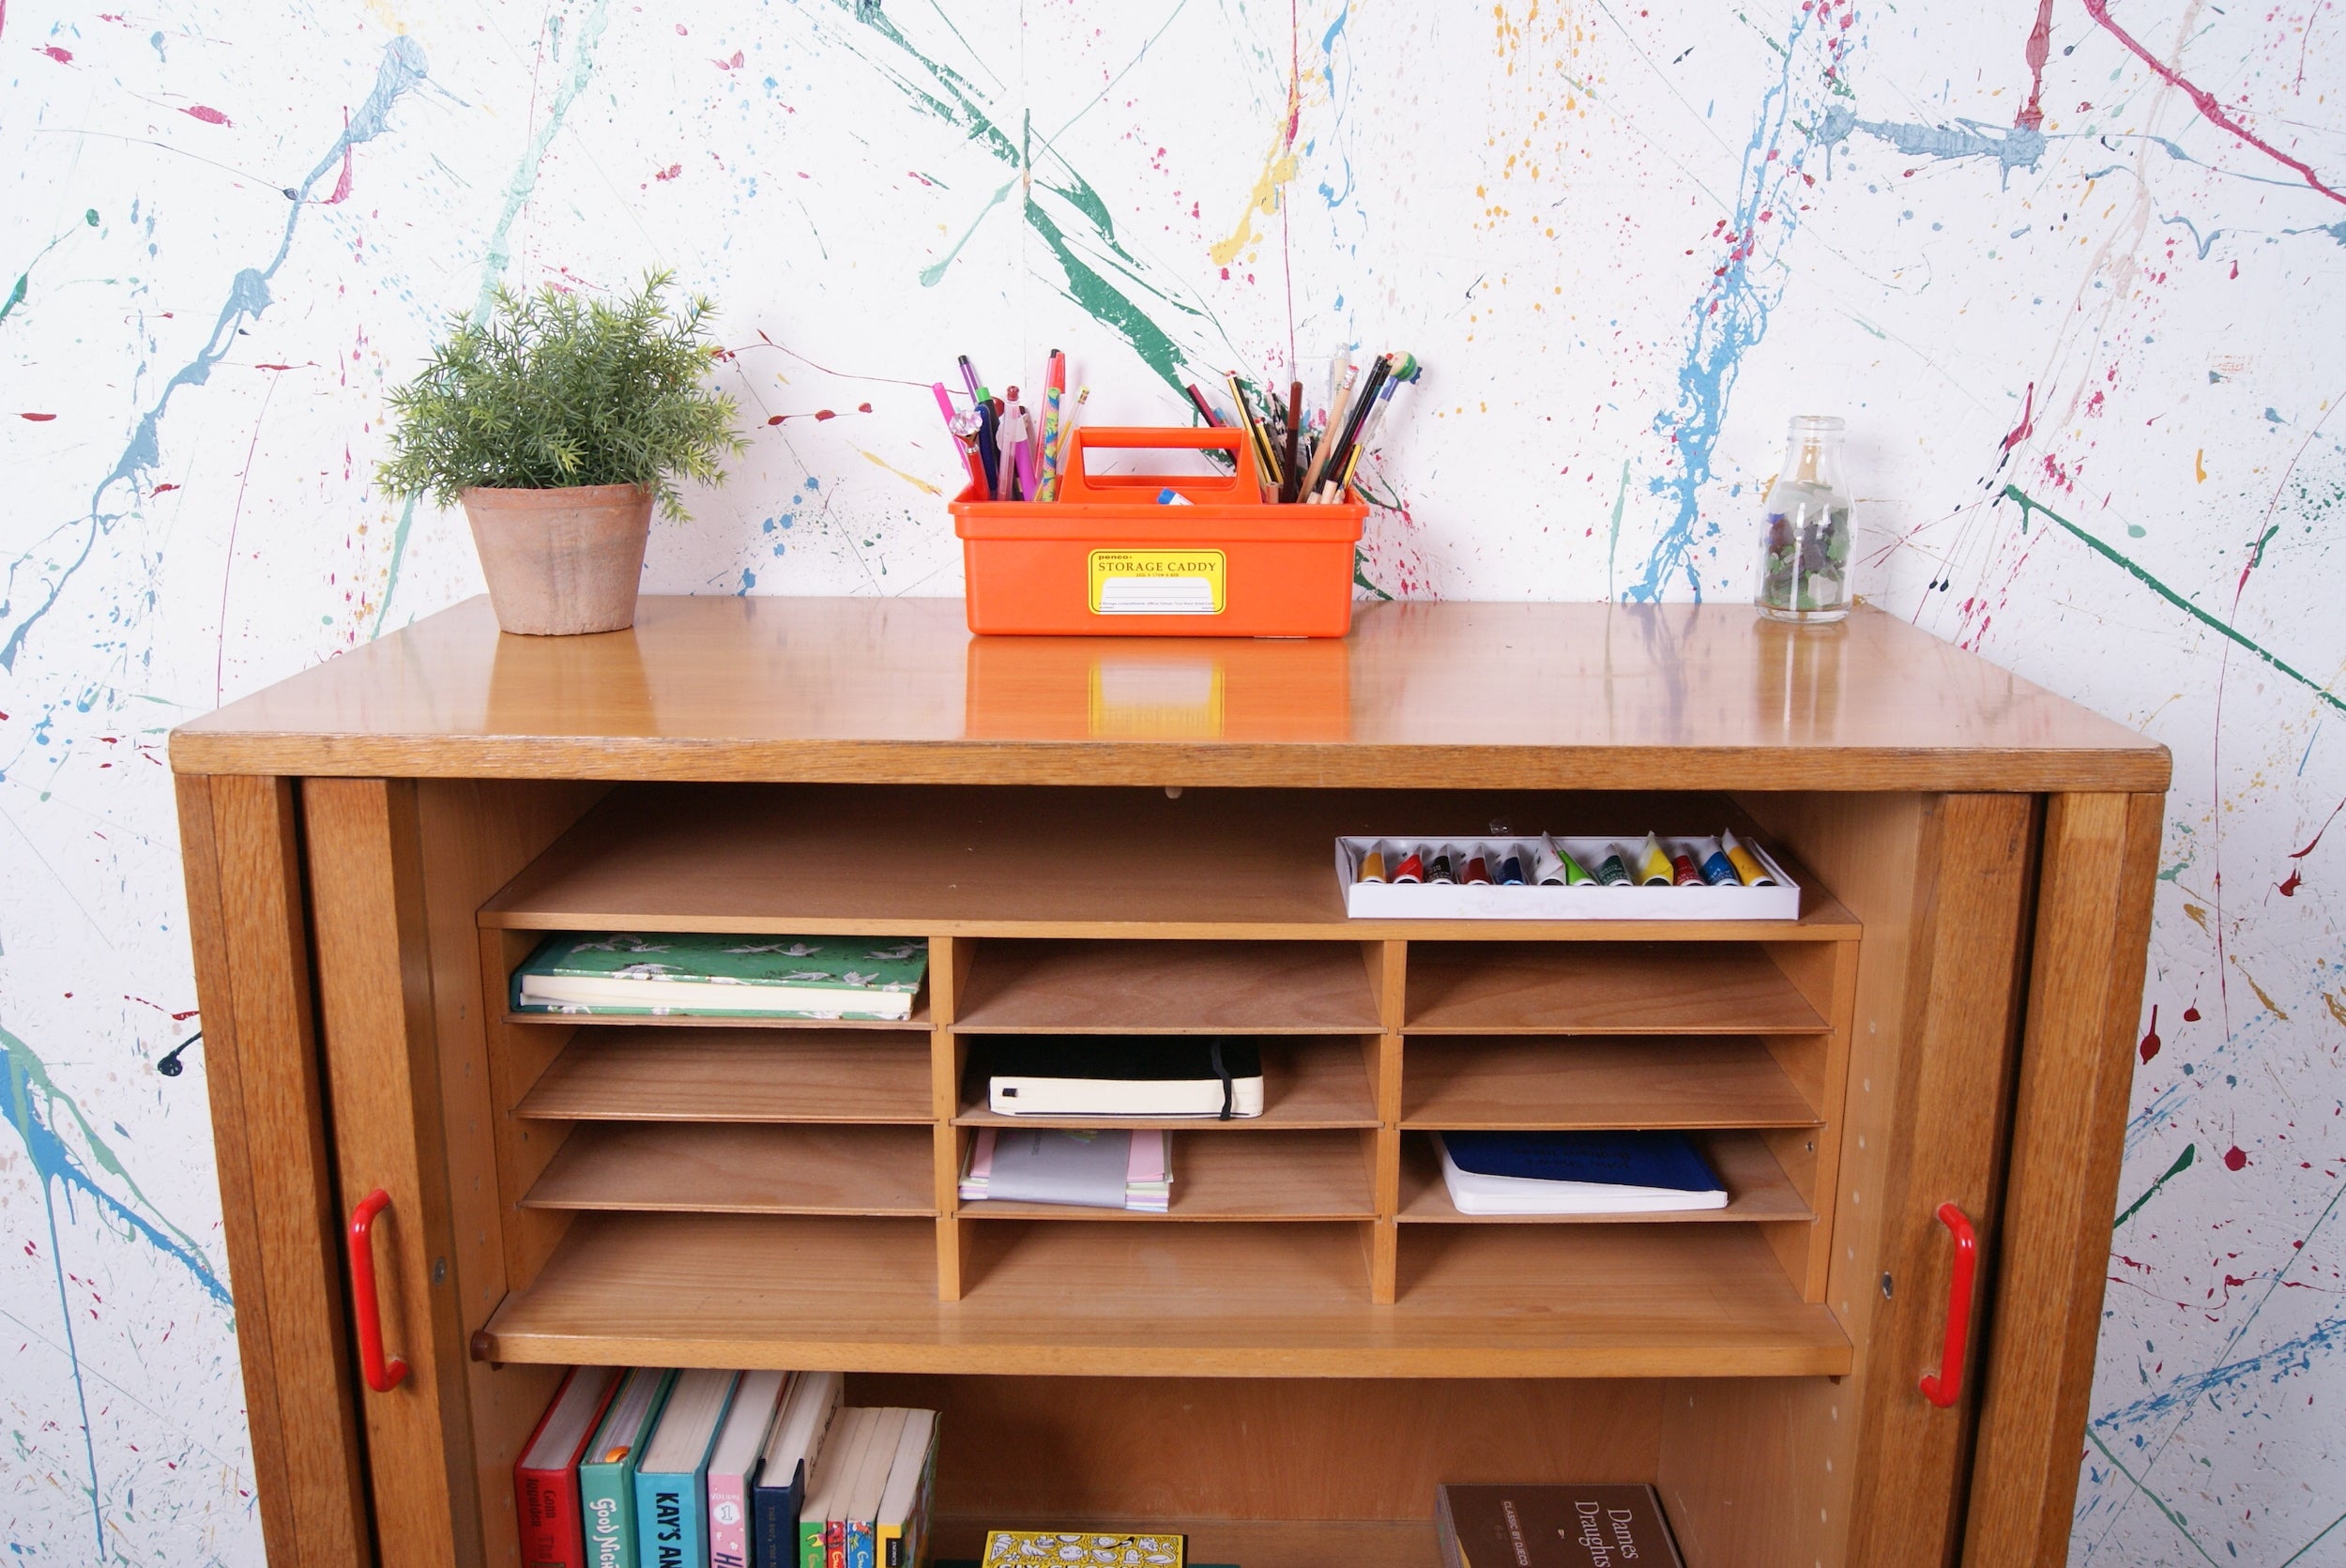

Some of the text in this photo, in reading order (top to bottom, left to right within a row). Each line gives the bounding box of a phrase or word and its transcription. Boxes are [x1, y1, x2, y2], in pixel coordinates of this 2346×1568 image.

[1098, 562, 1216, 571] STORAGE CADDY
[656, 1493, 682, 1540] KAY'S
[721, 1505, 733, 1521] 1
[1503, 1500, 1529, 1565] CLASSIC BY DJECO
[1575, 1501, 1616, 1568] Draughts
[1607, 1509, 1639, 1560] Dames
